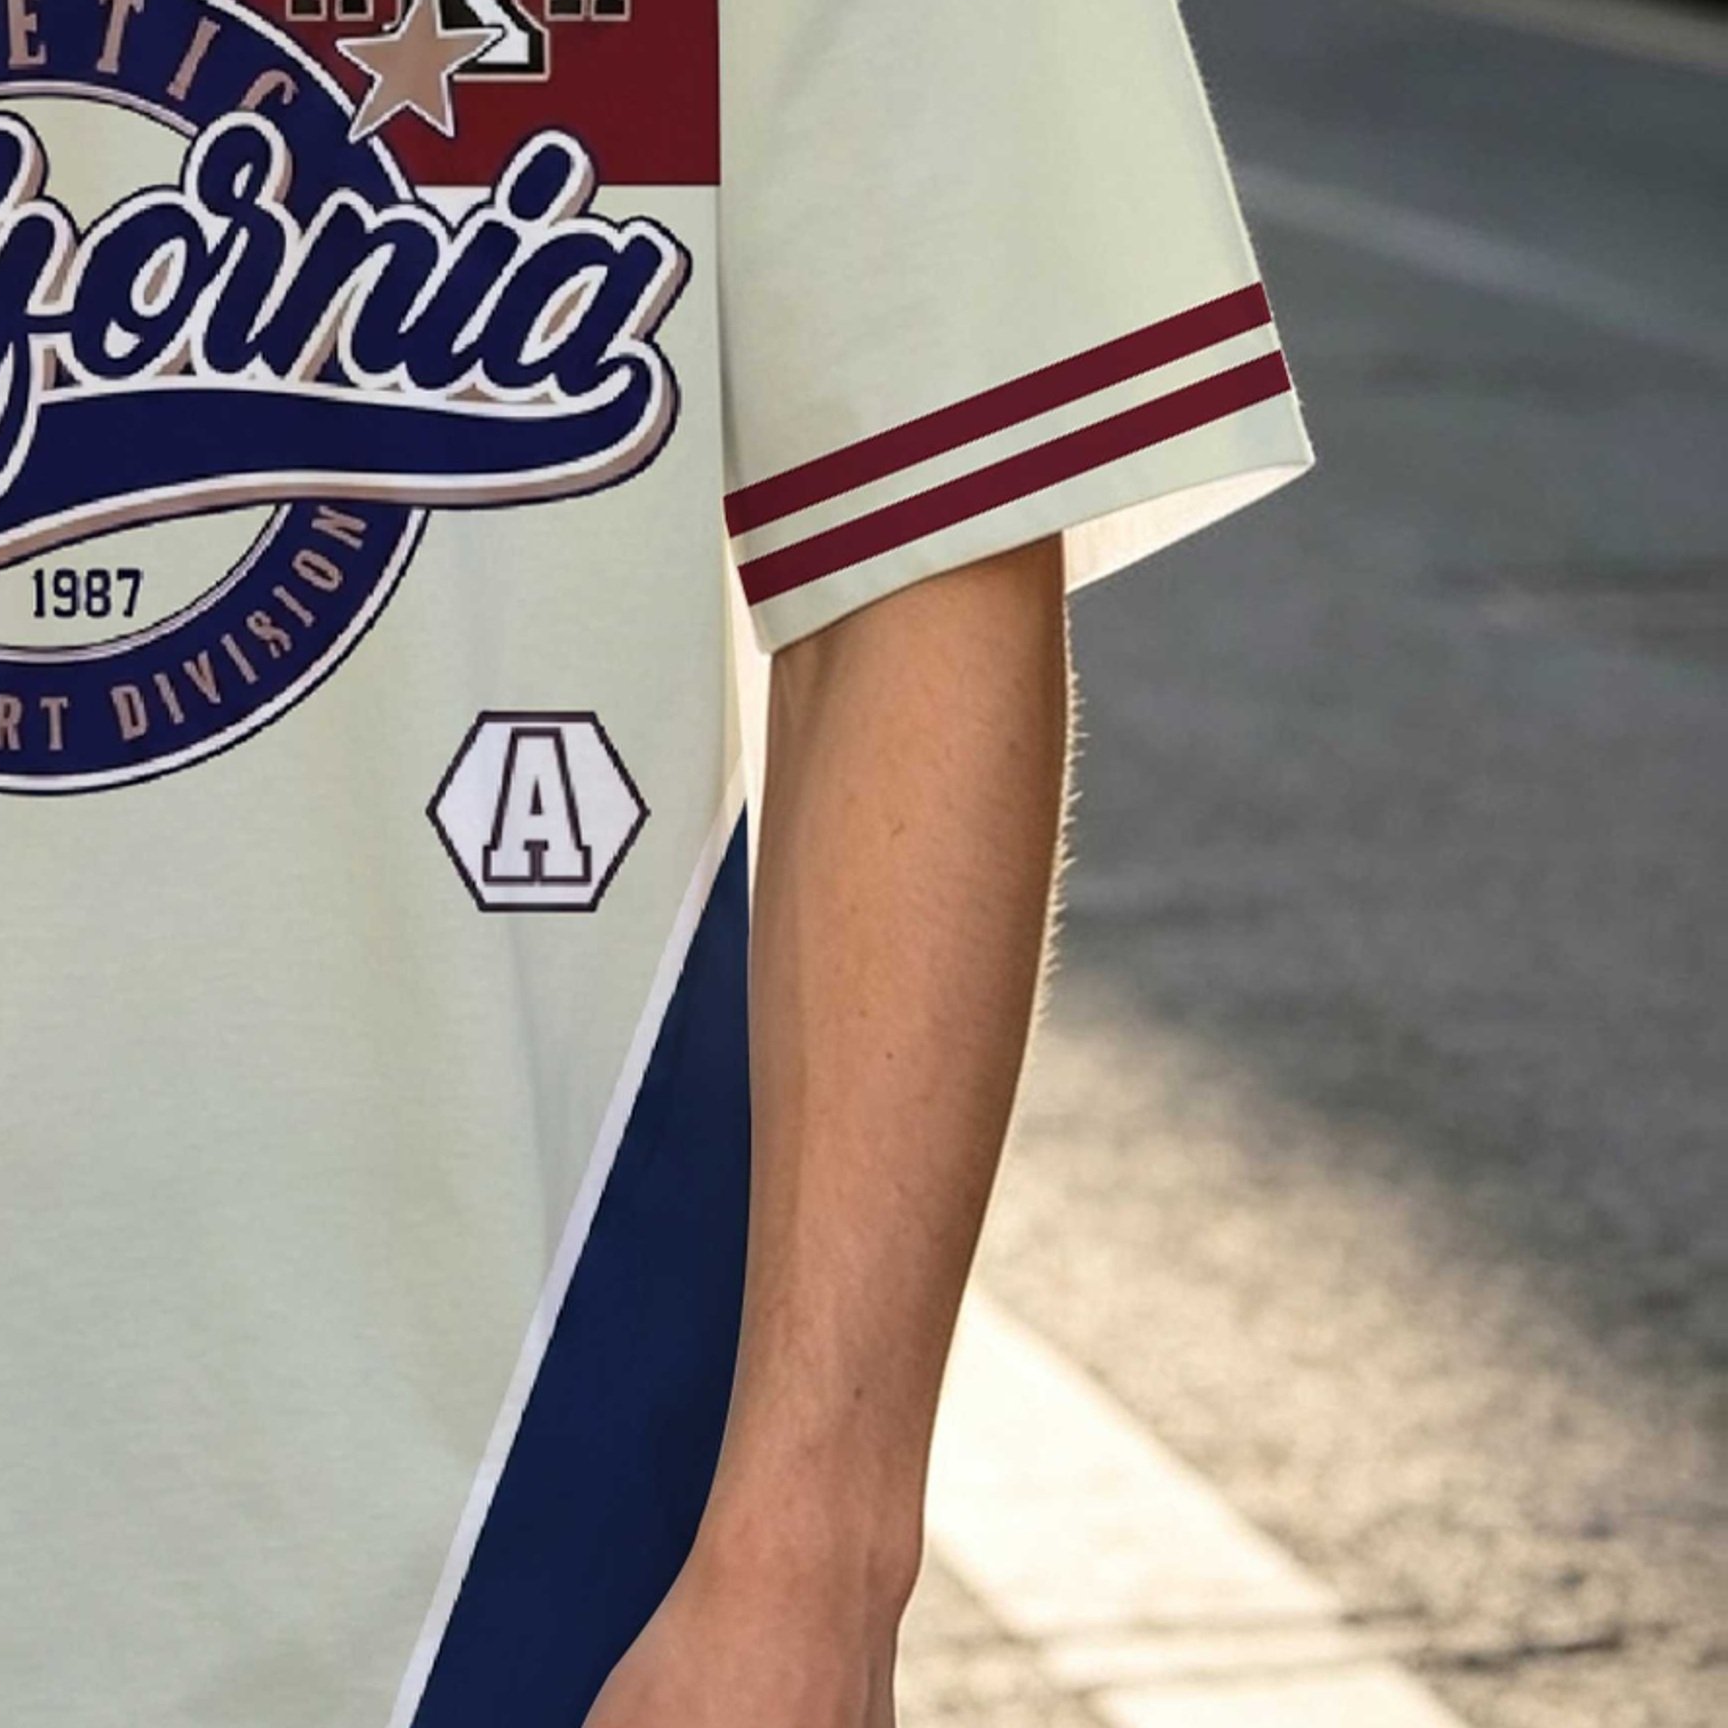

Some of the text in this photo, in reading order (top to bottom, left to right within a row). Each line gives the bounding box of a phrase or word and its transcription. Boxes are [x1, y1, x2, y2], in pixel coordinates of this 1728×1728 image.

[31, 567, 144, 618] 1987
[110, 504, 372, 742] DIVISION
[482, 726, 592, 886] A
